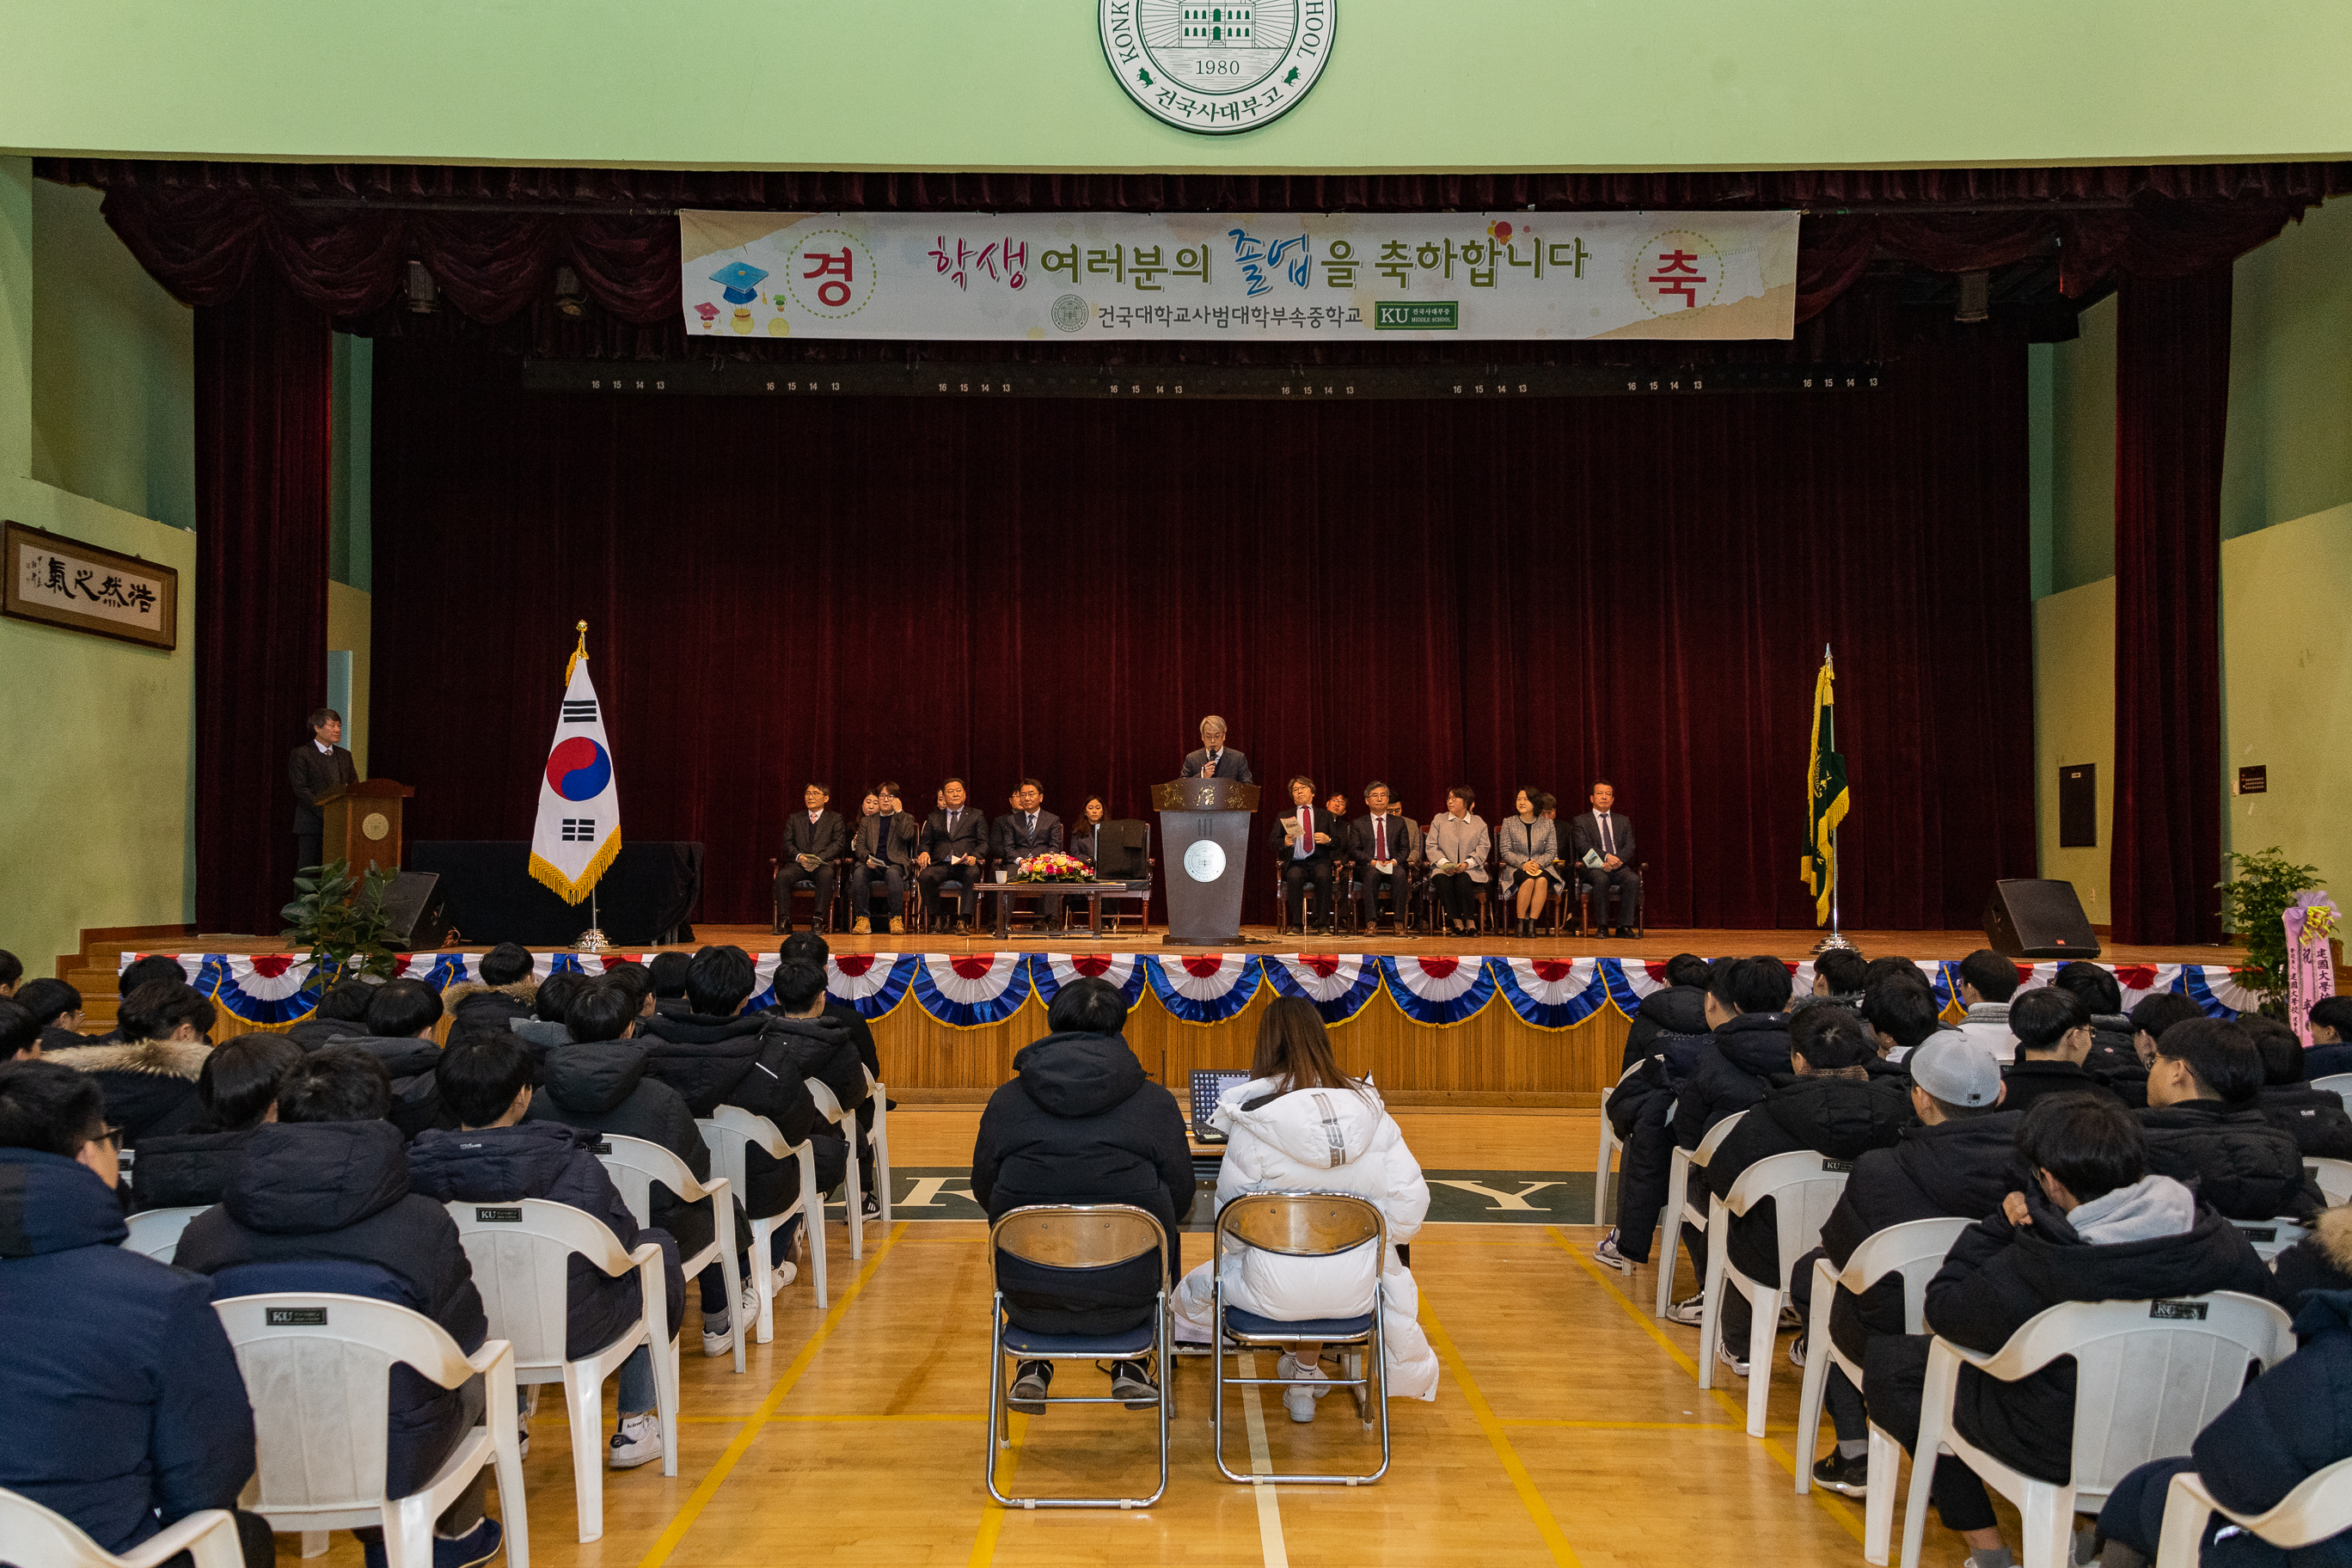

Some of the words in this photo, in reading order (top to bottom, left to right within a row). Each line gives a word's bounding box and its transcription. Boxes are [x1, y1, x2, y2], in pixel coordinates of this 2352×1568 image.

[1195, 59, 1240, 76] 1980
[1155, 85, 1284, 123] 건국사대부고
[927, 235, 1028, 291] 학생
[1039, 242, 1213, 292] 여러분의
[1374, 236, 1589, 291] 축하합니다
[802, 246, 854, 307] 경
[1647, 248, 1707, 309] 축
[1098, 305, 1363, 328] 건국대학교사범대학부속중학교
[1381, 308, 1410, 323] KU
[591, 380, 600, 389] 16
[613, 380, 622, 389] 15
[635, 380, 644, 389] 14
[656, 381, 665, 389] 13
[766, 382, 775, 391] 16
[787, 382, 797, 391] 15
[809, 382, 818, 391] 14
[830, 382, 840, 391] 13
[938, 383, 947, 392] 16
[959, 383, 969, 392] 15
[981, 383, 989, 392] 14
[1001, 383, 1011, 392] 13
[1627, 382, 1637, 391] 16
[1649, 381, 1658, 390] 15
[1669, 381, 1679, 390] 14
[1694, 380, 1702, 389] 13
[1803, 378, 1812, 388] 16
[1824, 378, 1834, 388] 15
[1846, 378, 1855, 387] 14
[1869, 377, 1878, 387] 13
[1110, 384, 1118, 394] 16
[1131, 384, 1141, 394] 15
[1155, 385, 1164, 394] 14
[1174, 385, 1183, 394] 13
[1281, 386, 1290, 395] 16
[1303, 386, 1313, 395] 15
[1324, 386, 1333, 395] 14
[1345, 386, 1354, 395] 13
[1453, 385, 1462, 394] 16
[1474, 384, 1484, 394] 15
[1498, 384, 1506, 394] 14
[1518, 383, 1528, 393] 13
[481, 1210, 496, 1219] KU
[273, 1311, 293, 1321] KU
